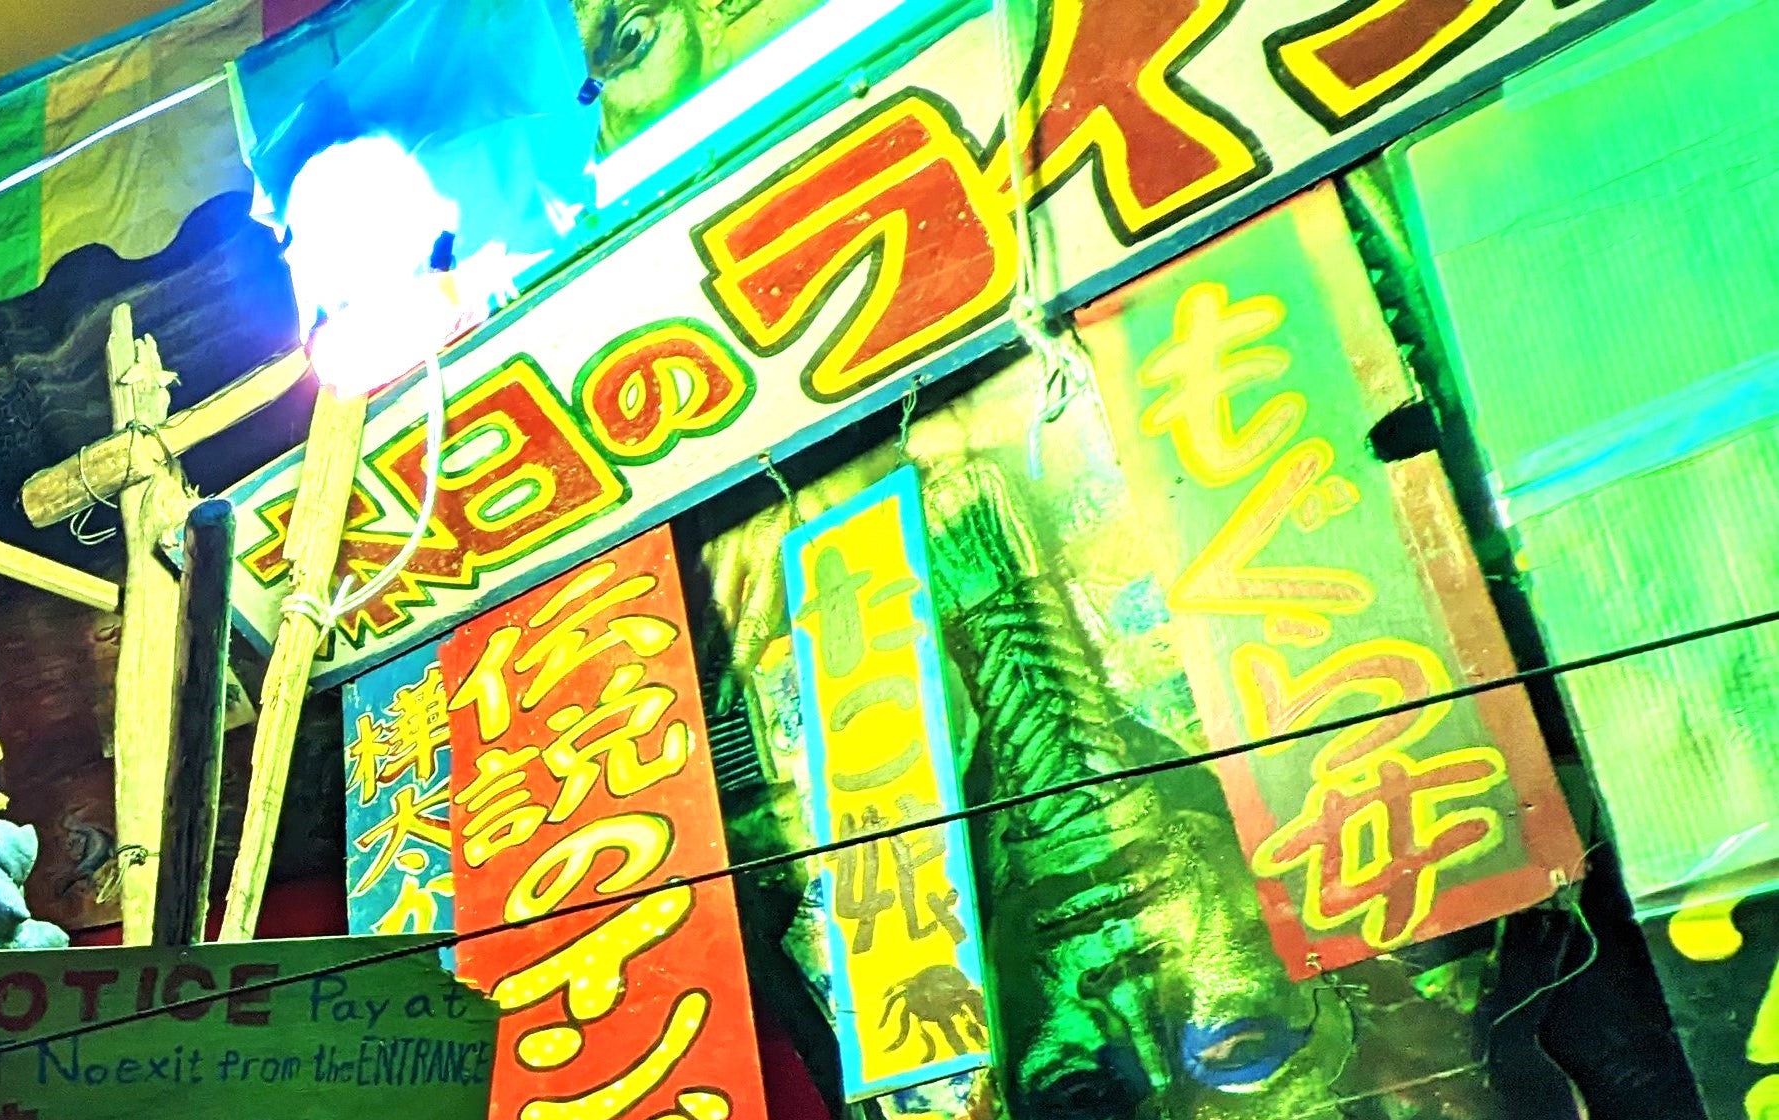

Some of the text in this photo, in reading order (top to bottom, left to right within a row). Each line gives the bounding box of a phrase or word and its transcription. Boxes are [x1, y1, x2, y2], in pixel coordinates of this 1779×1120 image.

[236, 0, 1541, 656] 本日のライ
[796, 545, 966, 954] たこ娘
[1136, 282, 1505, 949] もぐら女
[217, 1050, 301, 1083] from
[356, 1036, 490, 1087] ENTRANCE
[311, 973, 390, 1029] Pay
[405, 988, 468, 1019] at
